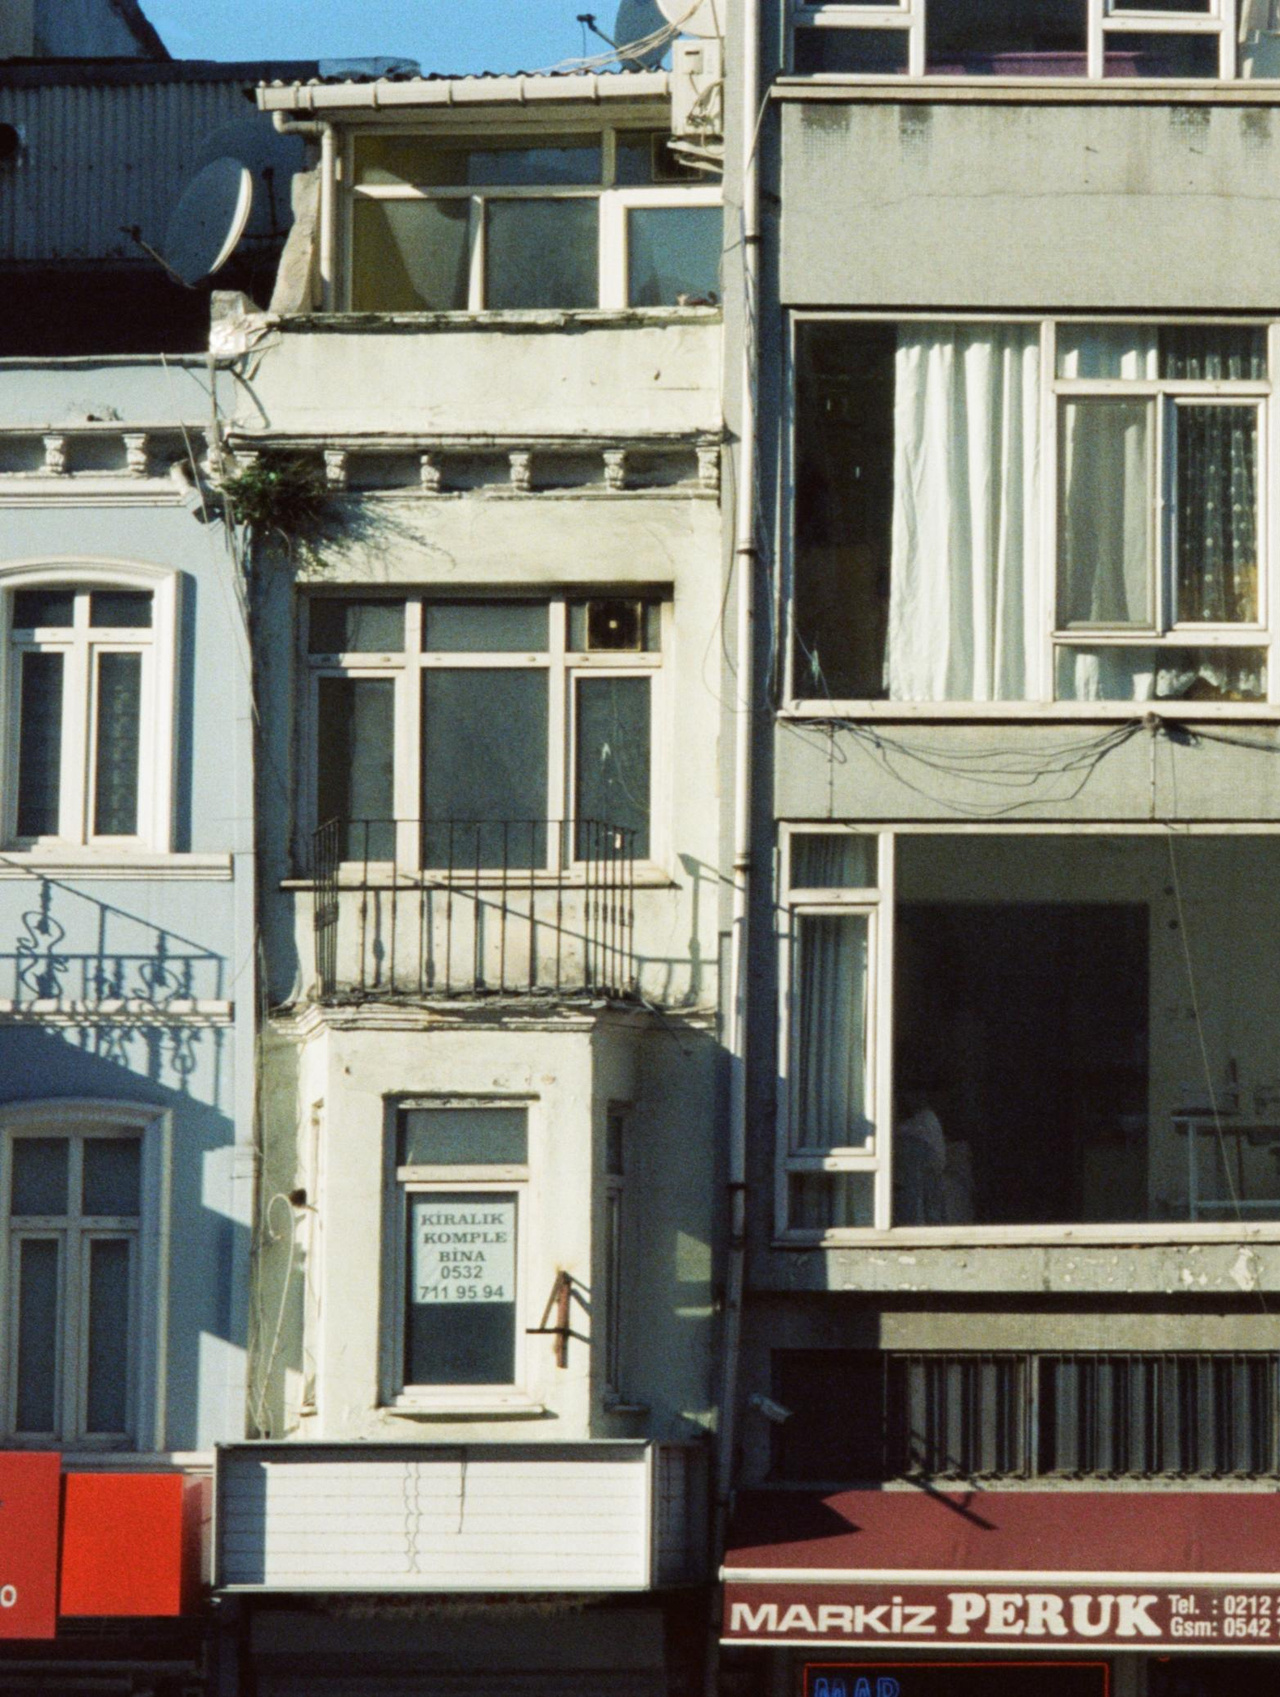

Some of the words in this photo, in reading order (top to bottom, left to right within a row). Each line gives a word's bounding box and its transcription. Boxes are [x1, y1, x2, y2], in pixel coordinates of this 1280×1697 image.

[421, 1211, 504, 1226] KİRALIK
[424, 1232, 507, 1244] KOMPLE
[439, 1247, 485, 1262] BİNA
[441, 1265, 483, 1279] 0532
[420, 1286, 449, 1300] 711
[456, 1286, 477, 1299] 95
[483, 1285, 505, 1298] 94
[1224, 1595, 1271, 1615] 0212
[947, 1592, 1162, 1636] PERUK
[1170, 1617, 1218, 1637] Gsm:
[1224, 1617, 1271, 1637] 0542
